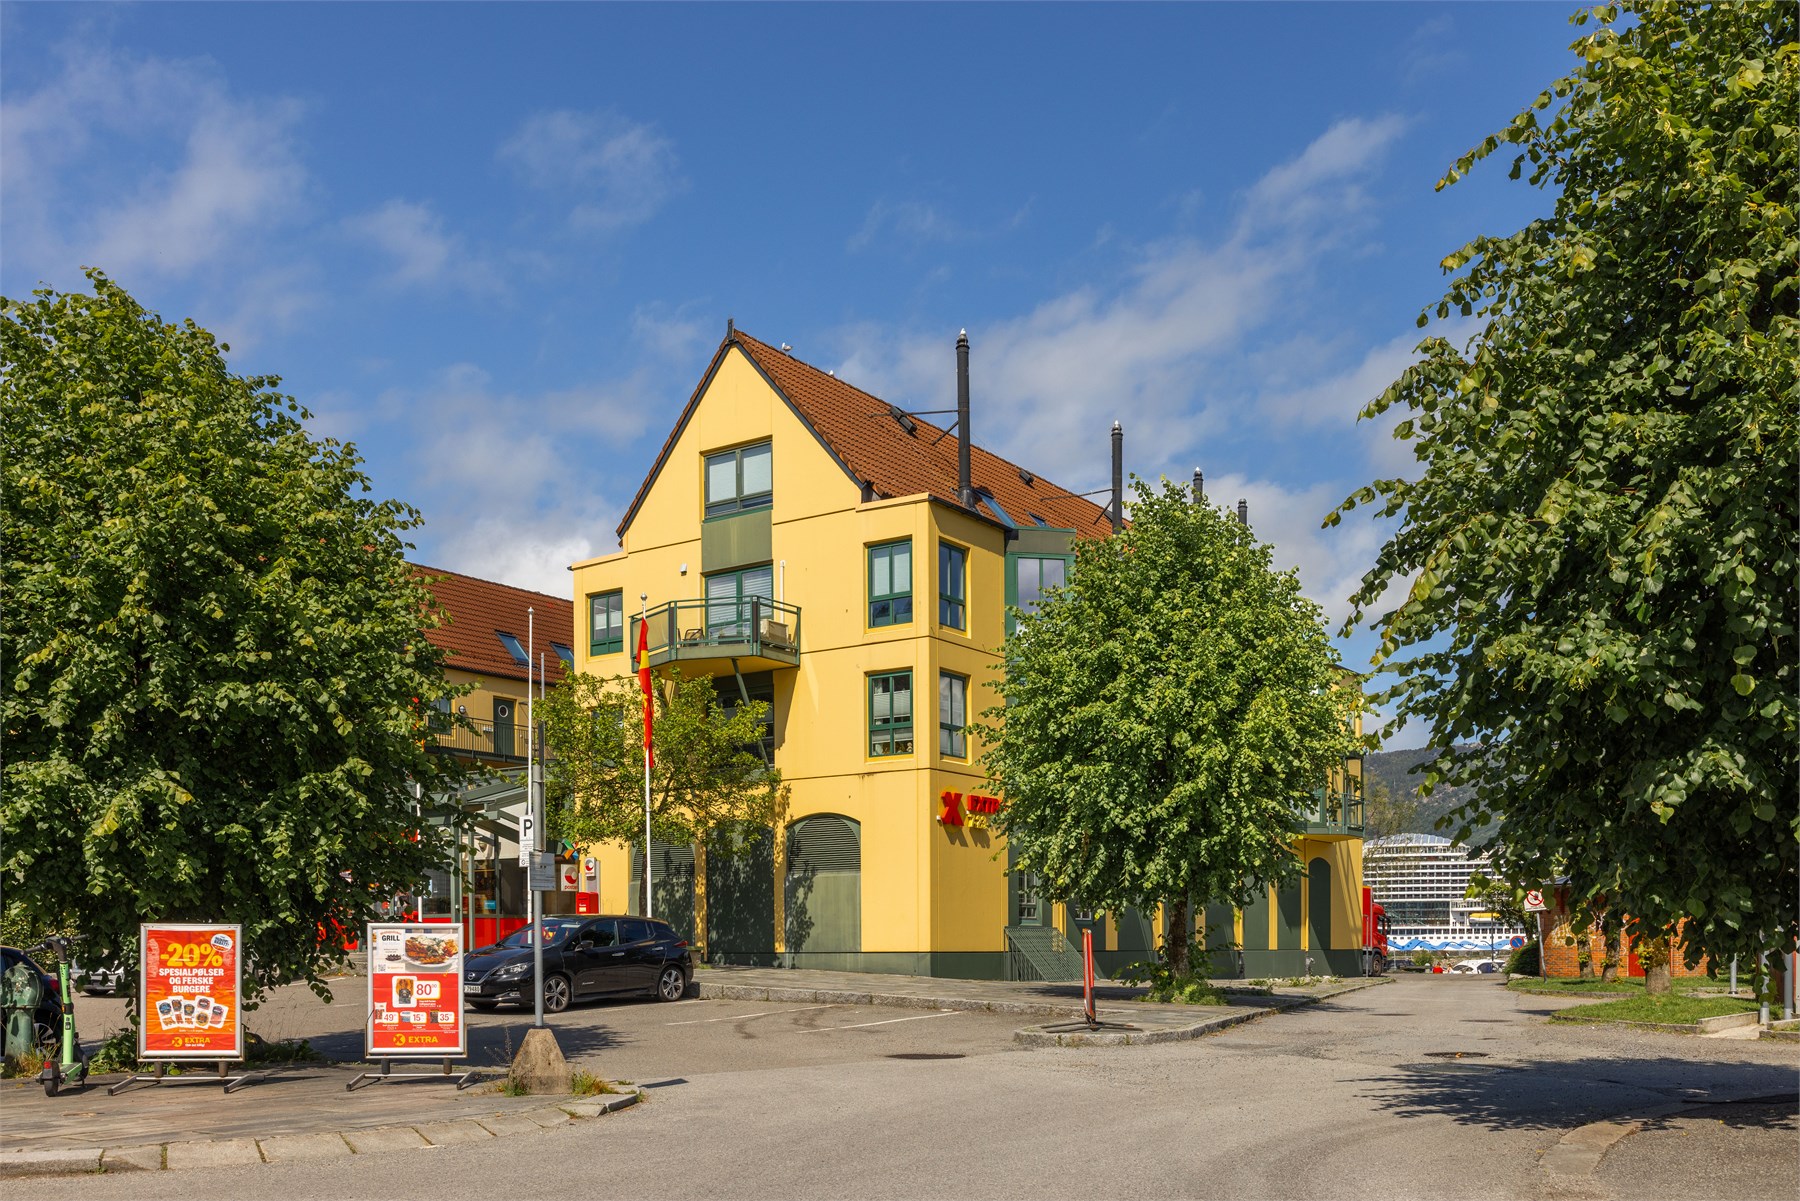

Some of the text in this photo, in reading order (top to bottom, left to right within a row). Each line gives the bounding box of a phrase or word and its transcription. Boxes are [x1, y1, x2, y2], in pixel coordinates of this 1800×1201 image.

[966, 794, 1003, 814] EXTR
[523, 819, 533, 837] P
[381, 934, 400, 942] GRILL
[160, 943, 223, 967] -20%
[158, 968, 224, 977] SPESIALPØLSER
[169, 977, 214, 985] OG FERSKE
[172, 985, 211, 993] BURGERE
[416, 983, 432, 996] 80
[408, 1036, 439, 1044] EXTRA
